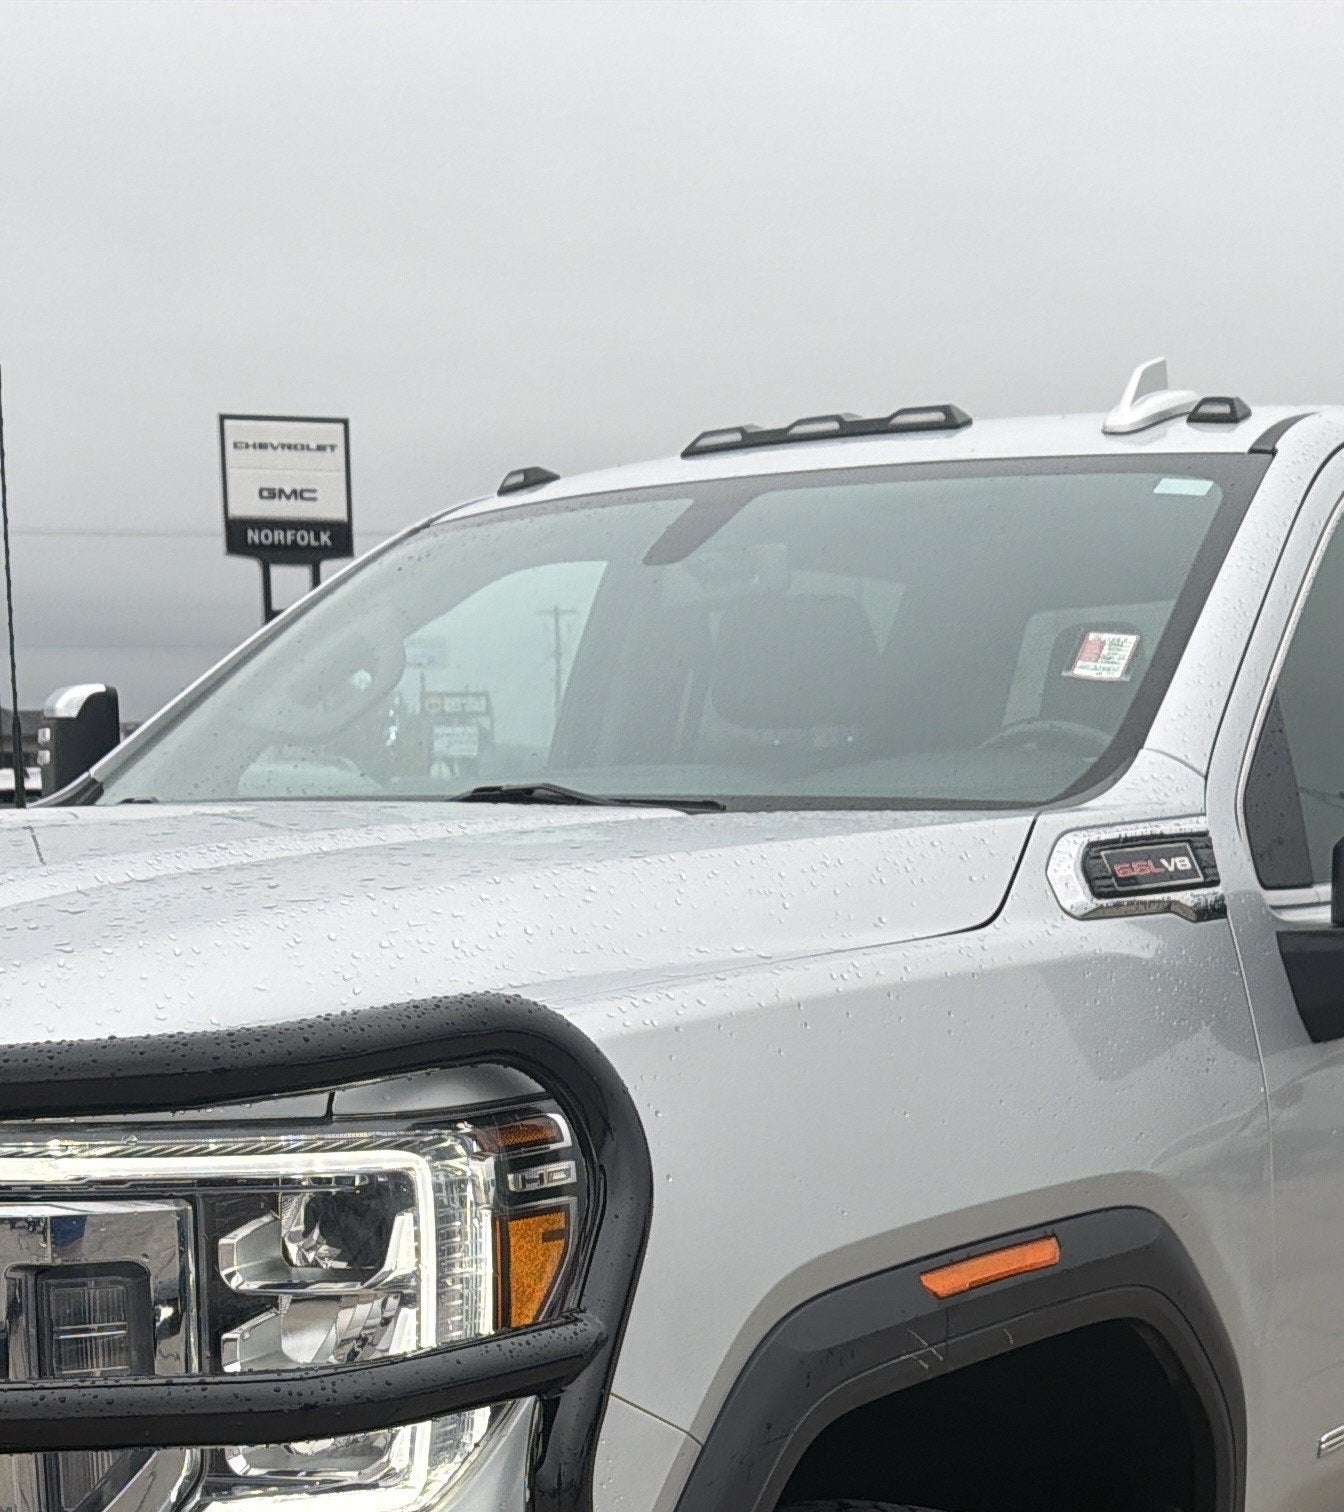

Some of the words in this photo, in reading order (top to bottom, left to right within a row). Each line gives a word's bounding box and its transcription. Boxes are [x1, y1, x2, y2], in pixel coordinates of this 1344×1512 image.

[233, 440, 338, 453] CHEVROLET
[258, 486, 318, 502] GMC
[247, 528, 333, 547] NORFOLK
[1160, 857, 1191, 872] V8
